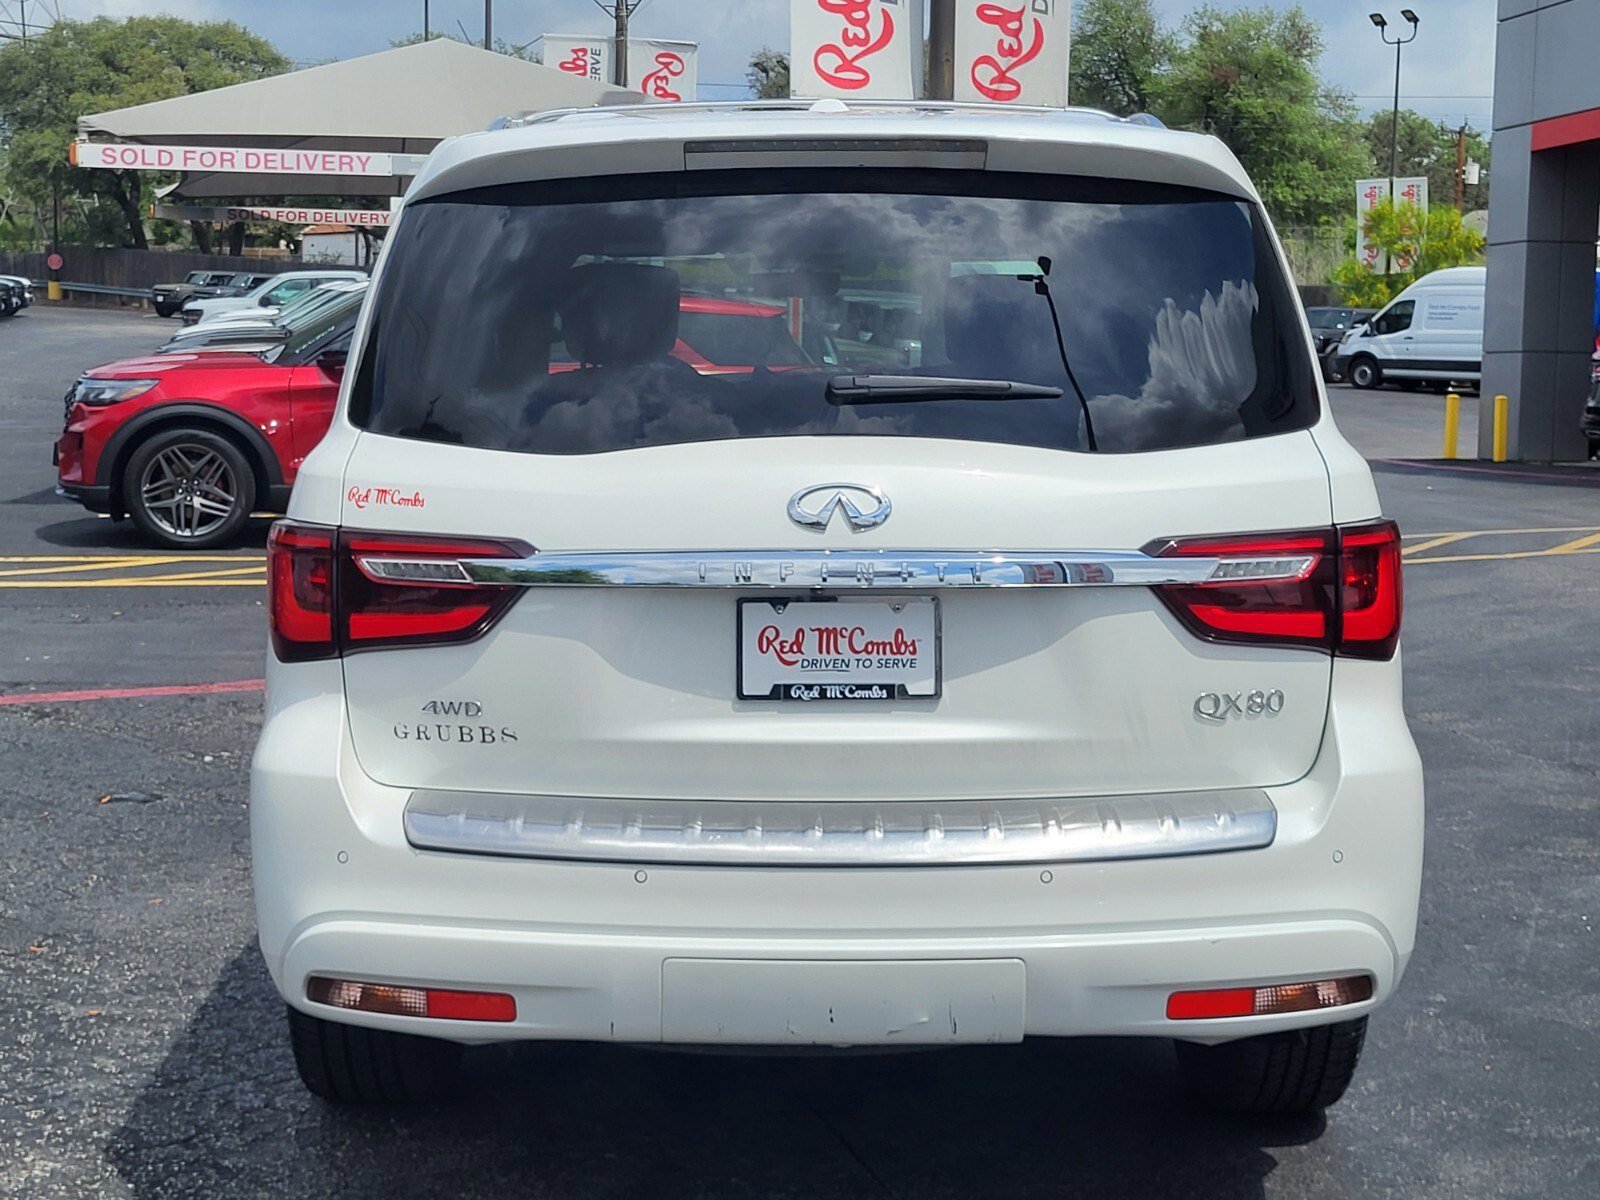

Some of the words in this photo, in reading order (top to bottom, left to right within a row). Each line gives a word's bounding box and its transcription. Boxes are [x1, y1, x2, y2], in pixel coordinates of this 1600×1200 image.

[971, 3, 1044, 101] Red
[641, 52, 685, 102] Red
[101, 147, 174, 167] SOLD
[183, 150, 236, 169] FOR
[244, 152, 372, 173] DELIVERY
[227, 208, 271, 222] SOLD
[276, 210, 308, 223] FOR
[313, 212, 390, 224] DELIVERY
[347, 485, 372, 509] Red
[374, 488, 425, 508] McCombs
[698, 562, 983, 584] INFINITI
[757, 625, 805, 667] Red
[809, 626, 918, 656] McCombs
[800, 658, 851, 669] DRIVEN
[855, 658, 873, 669] TO
[876, 658, 918, 669] SERVE
[790, 683, 821, 700] Red
[822, 684, 888, 699] McCombs
[421, 700, 481, 717] 4WD
[1194, 688, 1285, 720] QX80
[393, 722, 519, 744] GRUBBS
